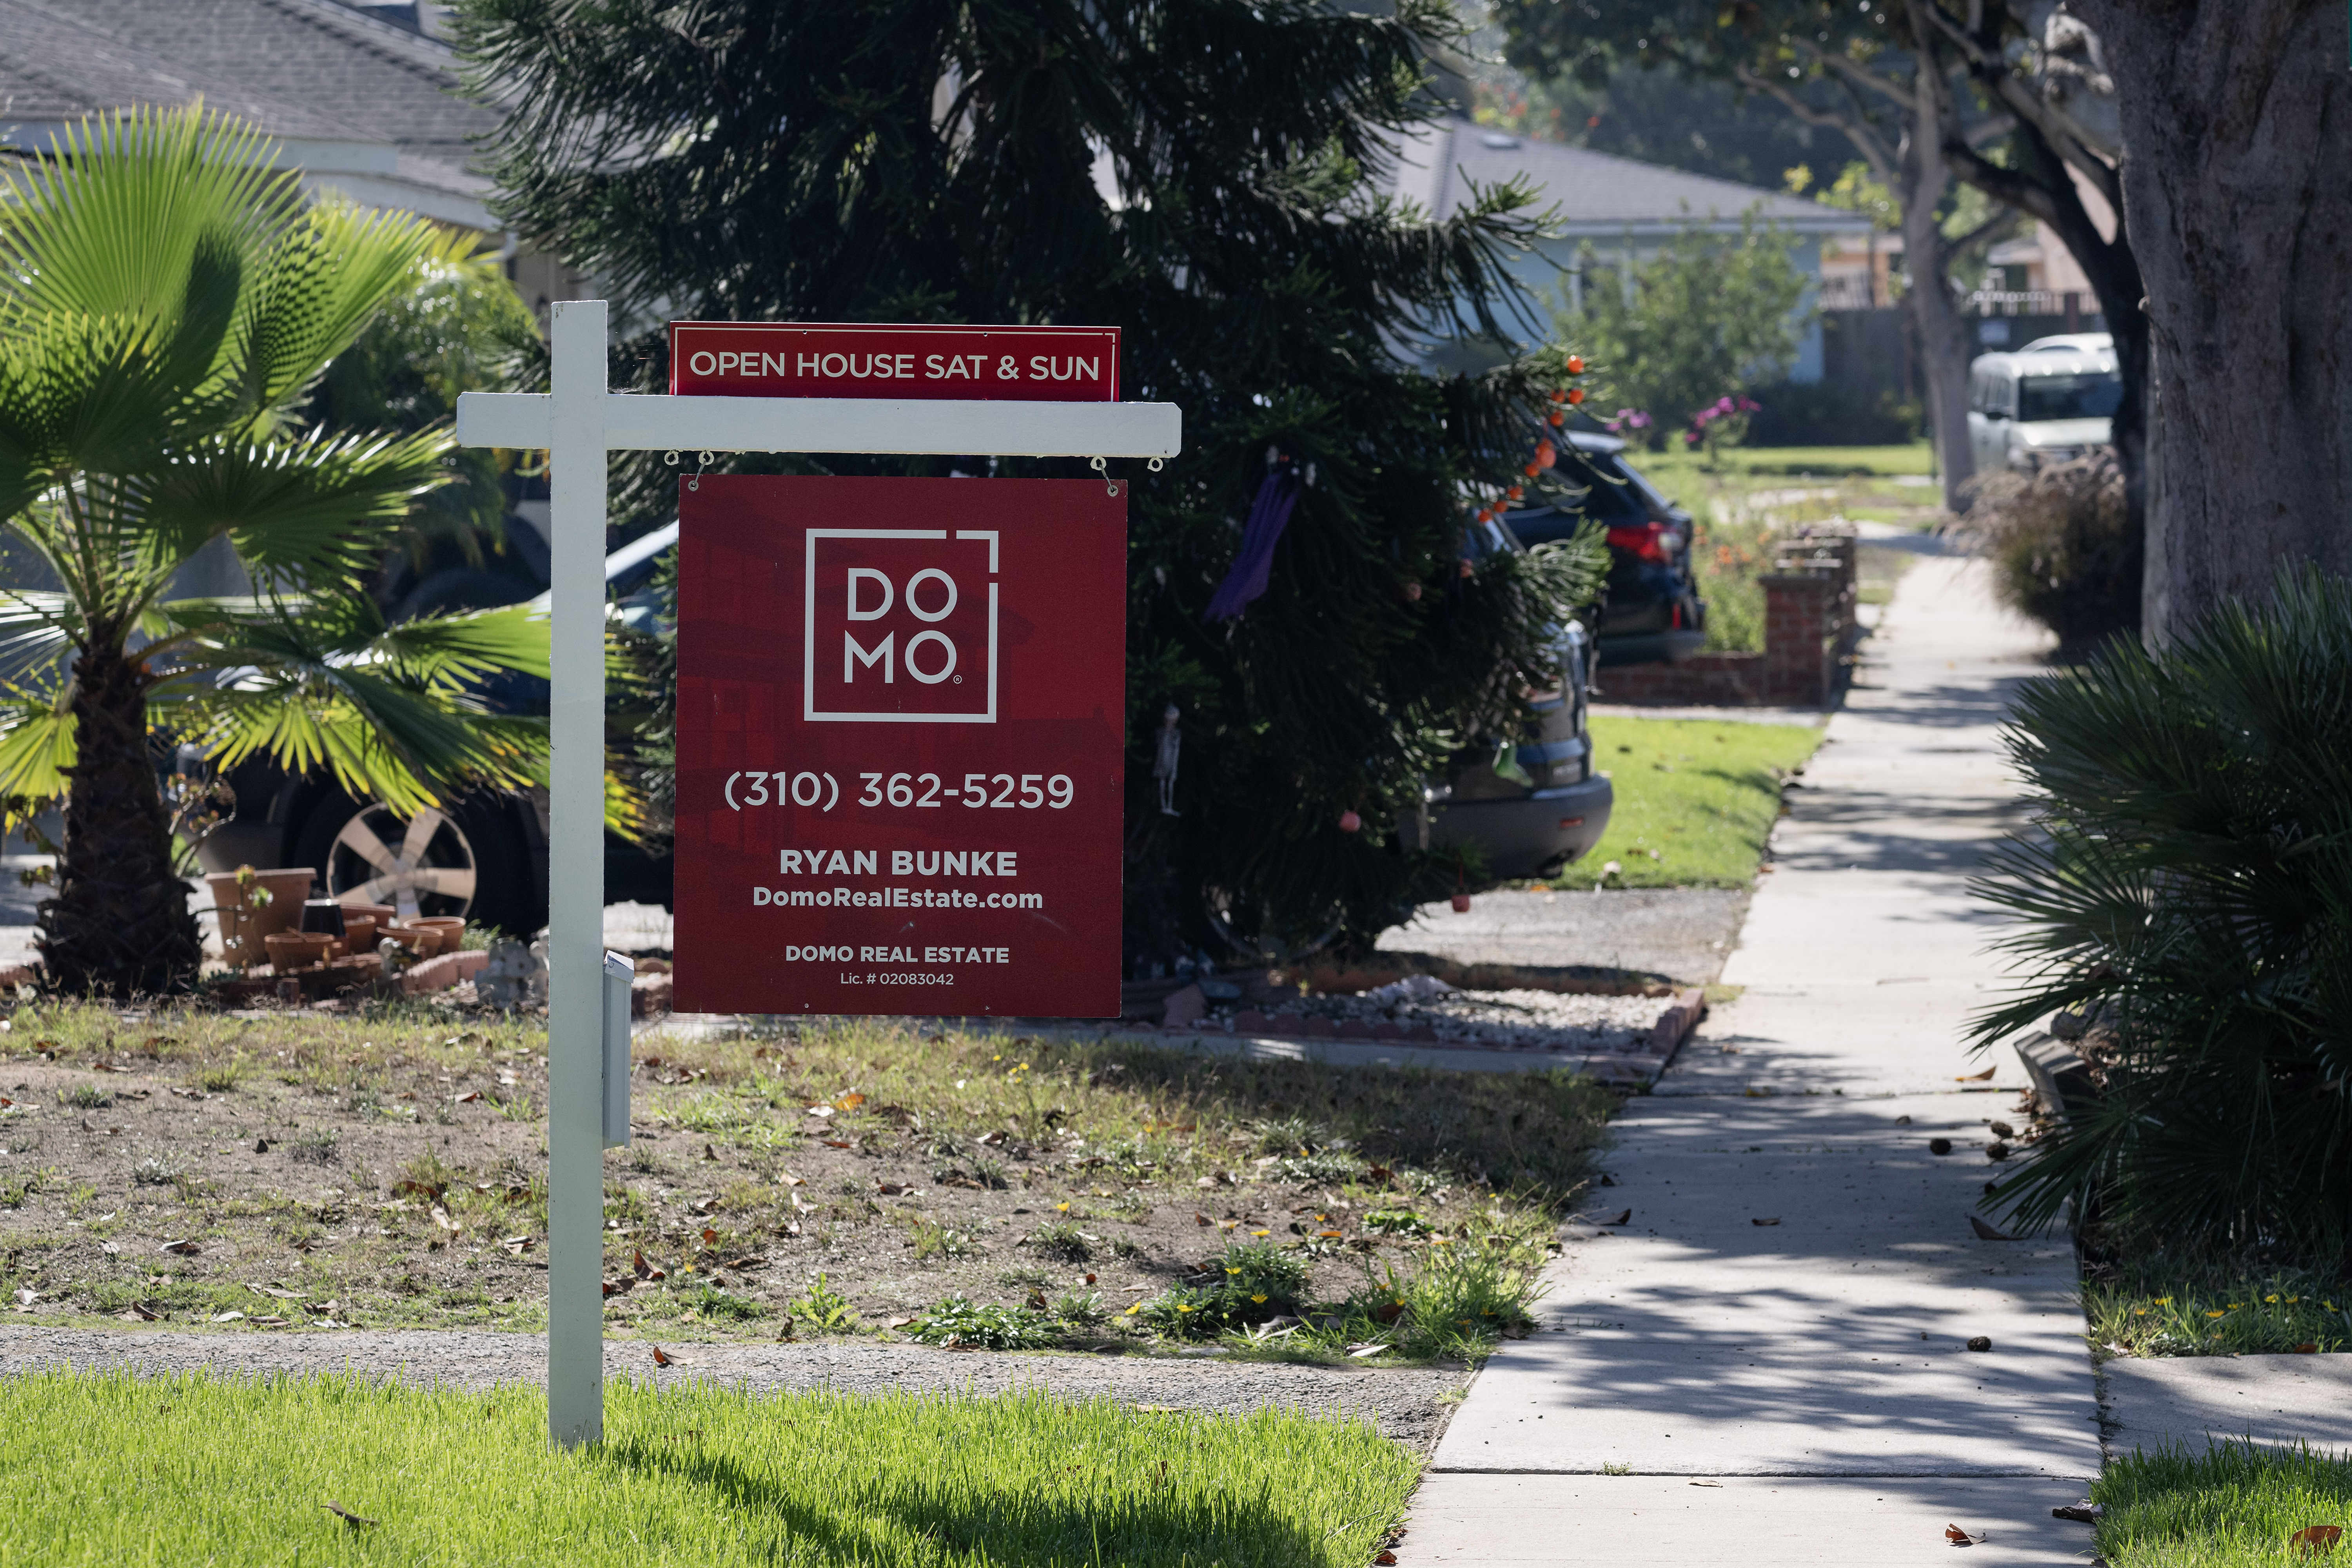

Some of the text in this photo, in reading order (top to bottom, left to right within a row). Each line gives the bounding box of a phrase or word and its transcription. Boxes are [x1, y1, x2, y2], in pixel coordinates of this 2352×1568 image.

[690, 351, 1099, 380] OPEN HOUSE SAT & SUN
[848, 568, 958, 622] DO
[725, 771, 1074, 812] (310) 362-5259
[780, 849, 1017, 876] RYAN BUNKE
[753, 887, 1042, 908] DomoRealEstate.com
[786, 946, 1009, 963] DOMO REAL ESTATE
[841, 973, 954, 985] Lic. # 02083042
